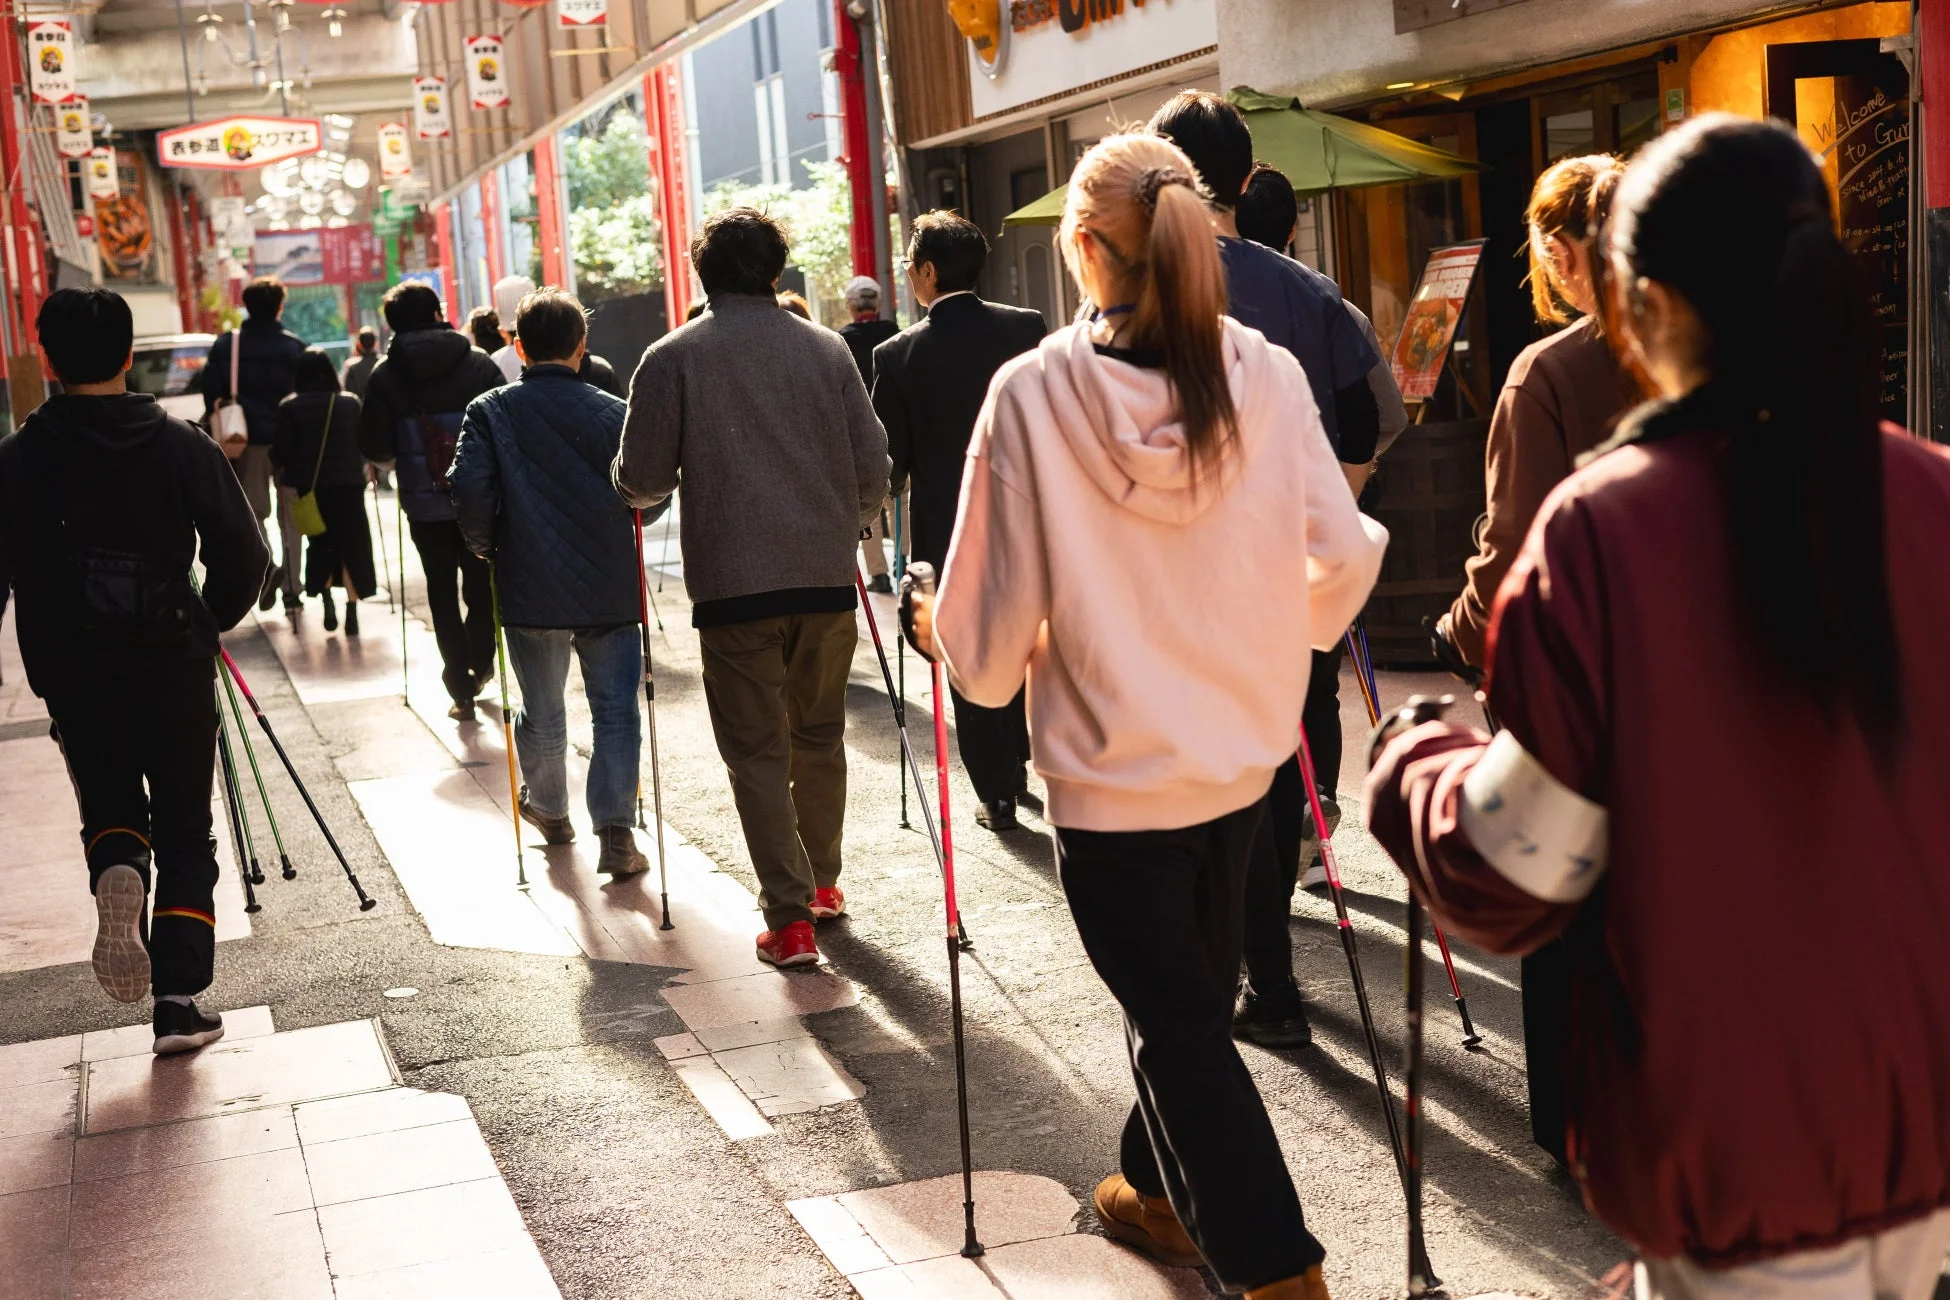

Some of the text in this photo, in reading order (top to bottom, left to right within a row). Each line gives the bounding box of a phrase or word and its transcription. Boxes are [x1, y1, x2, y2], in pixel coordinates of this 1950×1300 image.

[1812, 92, 1886, 144] Welcome
[252, 131, 311, 148] スワマエ
[1845, 143, 1867, 164] to
